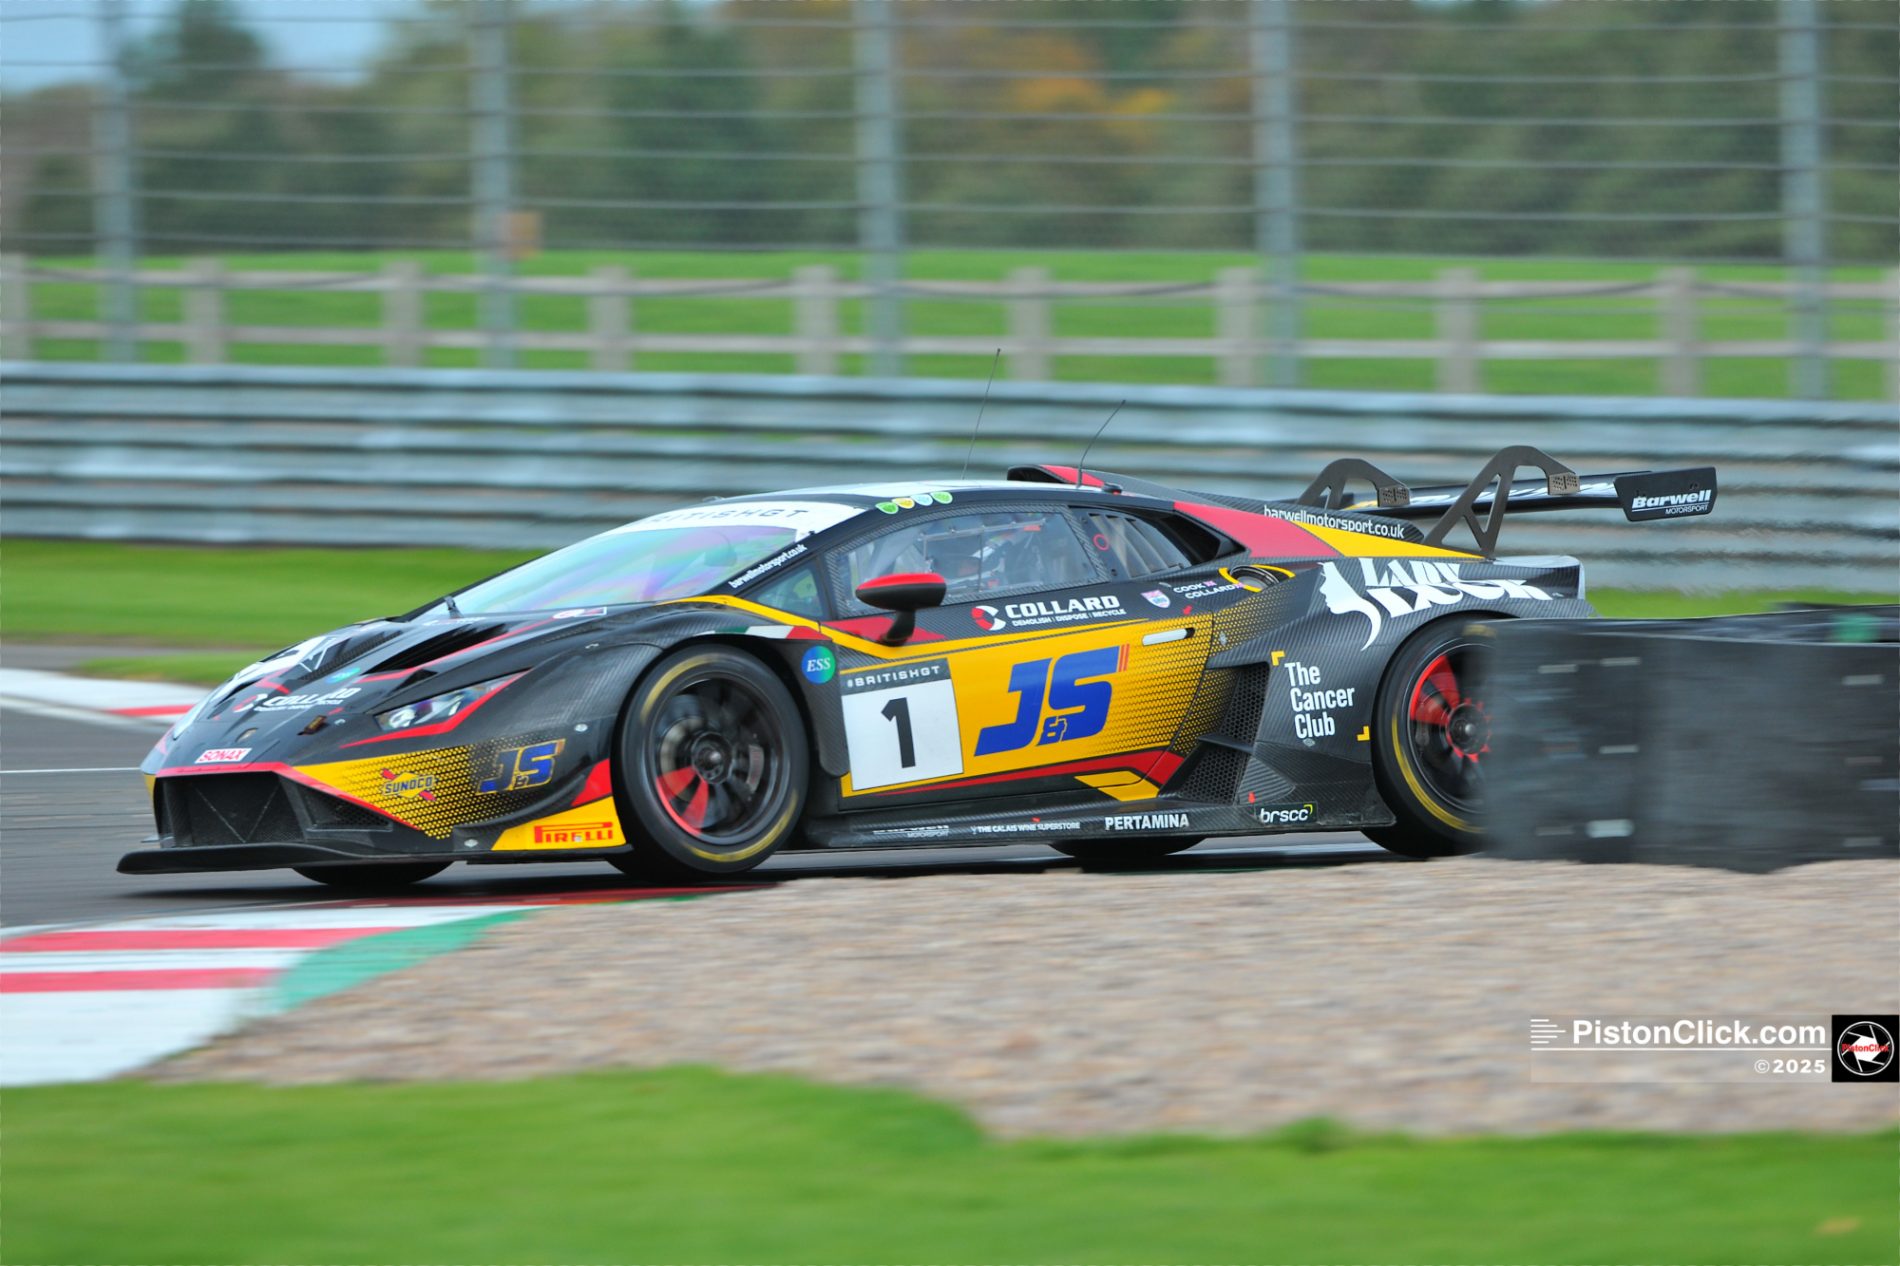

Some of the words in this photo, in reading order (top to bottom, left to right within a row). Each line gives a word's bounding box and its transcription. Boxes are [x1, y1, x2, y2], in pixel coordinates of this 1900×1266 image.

[1631, 489, 1712, 509] Barwell
[1665, 504, 1708, 515] MOTORSPORT
[1263, 505, 1405, 539] barwellmotorsport.co.uk
[1173, 582, 1206, 593] COOK
[1184, 584, 1236, 599] COLLARD
[1004, 595, 1121, 618] COLLARD
[1012, 616, 1052, 627] DEMOLISH
[1055, 612, 1089, 622] DISPOSE
[1092, 608, 1127, 618] RECYCLE
[806, 657, 832, 673] ESS
[1284, 661, 1321, 687] The
[847, 665, 941, 688] #BRITISHGT
[1290, 687, 1356, 712] Cancer
[880, 697, 916, 769] 1
[1294, 711, 1336, 739] Club
[199, 748, 248, 763] SONAX
[384, 775, 434, 795] SUNOCO
[1104, 813, 1190, 831] PERTAMINA
[1259, 806, 1309, 824] brscc
[534, 821, 613, 844] PIRELLI
[1018, 824, 1037, 832] WINE
[1037, 821, 1081, 831] SUPERSTORE
